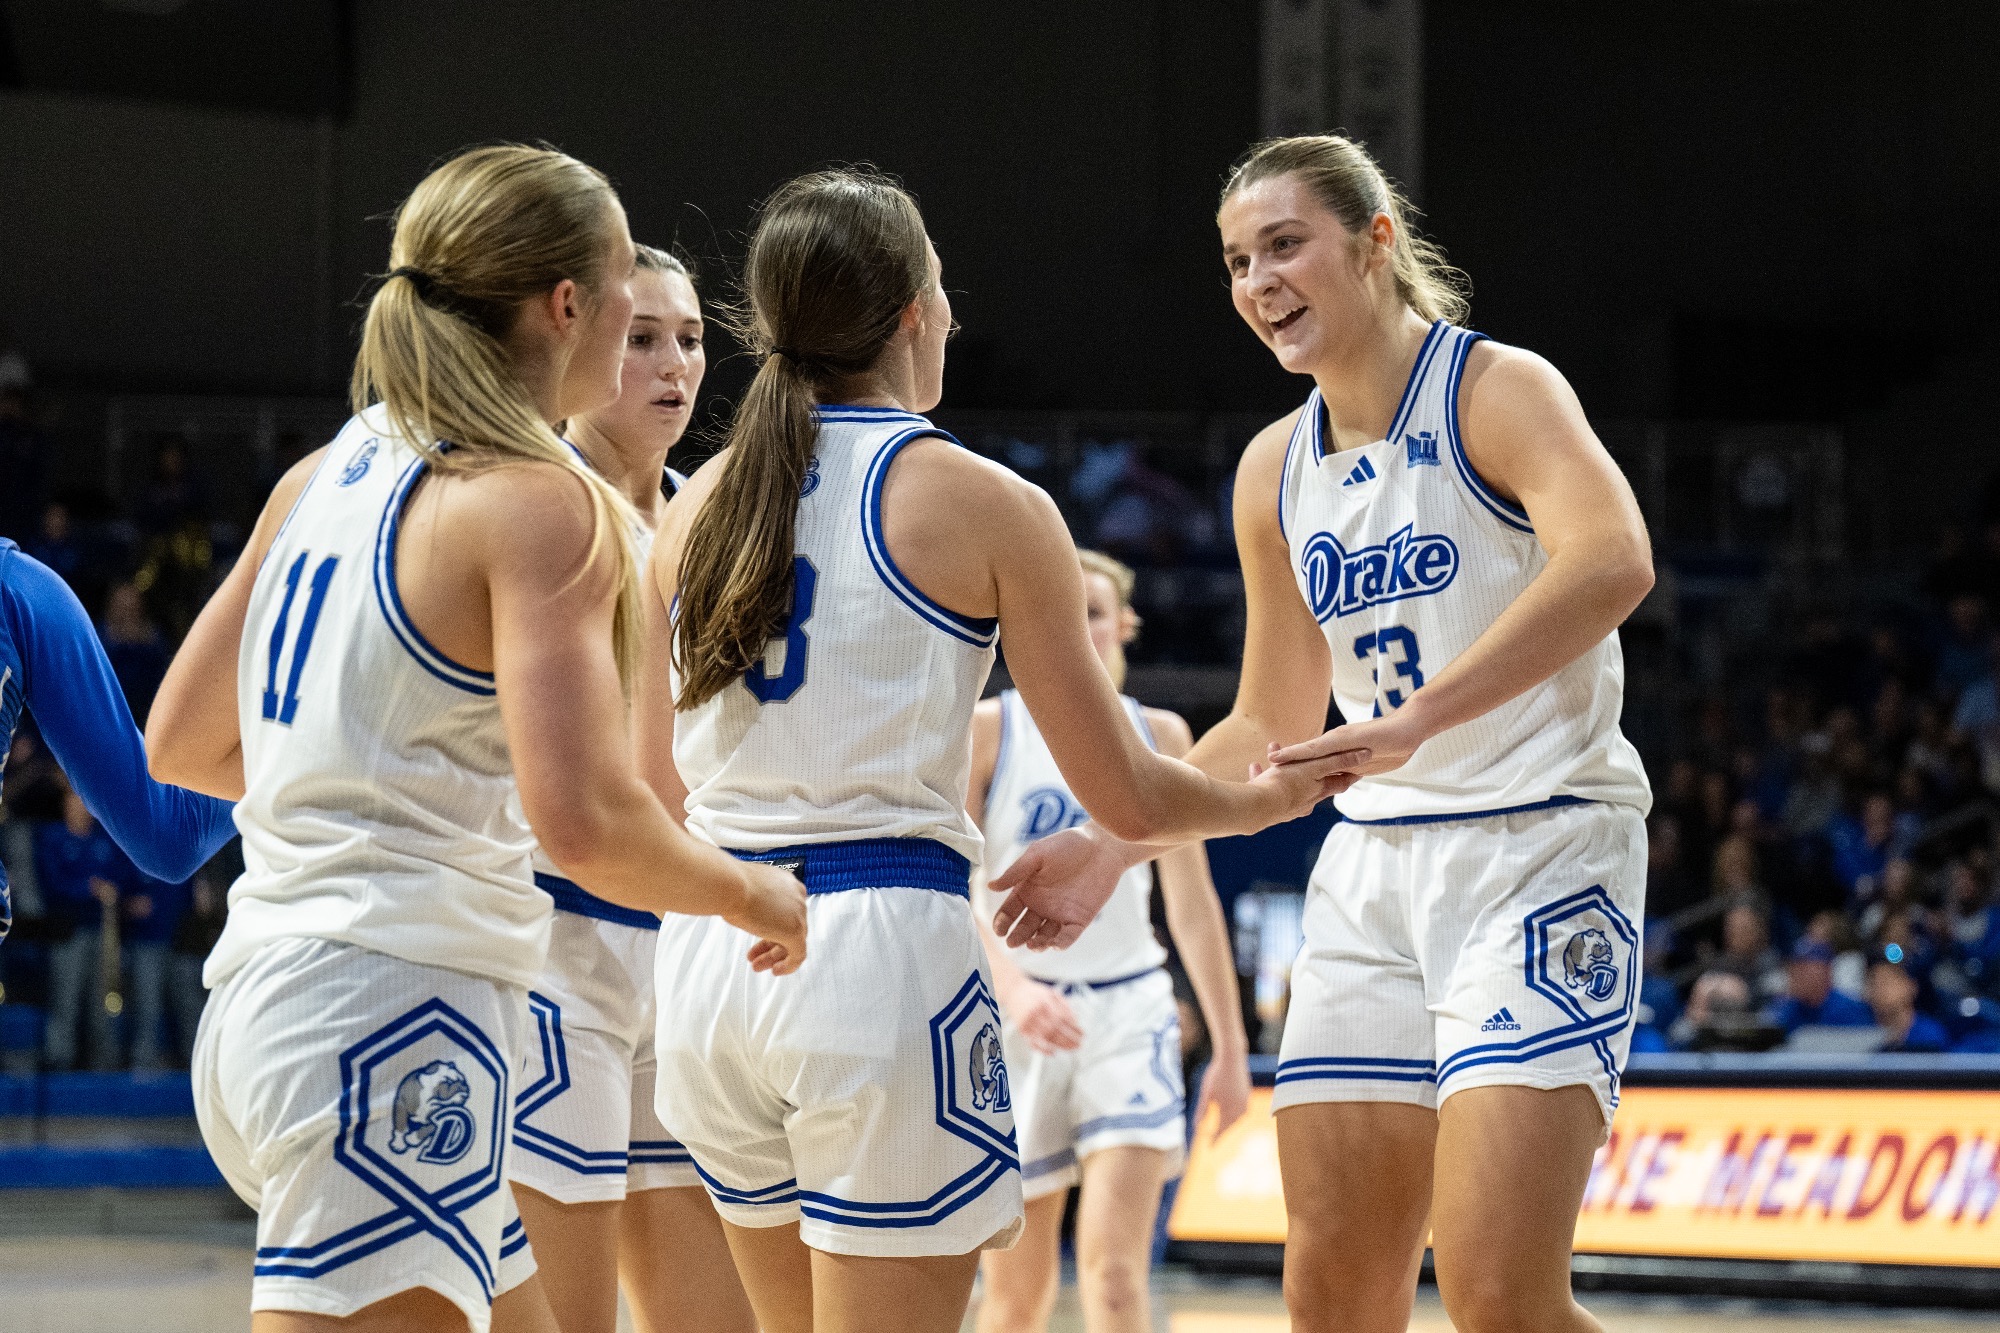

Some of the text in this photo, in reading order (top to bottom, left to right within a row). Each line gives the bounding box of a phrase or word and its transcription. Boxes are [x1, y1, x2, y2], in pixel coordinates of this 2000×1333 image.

[1301, 521, 1459, 625] Drake
[261, 549, 342, 729] 11
[1481, 1022, 1522, 1032] adidas
